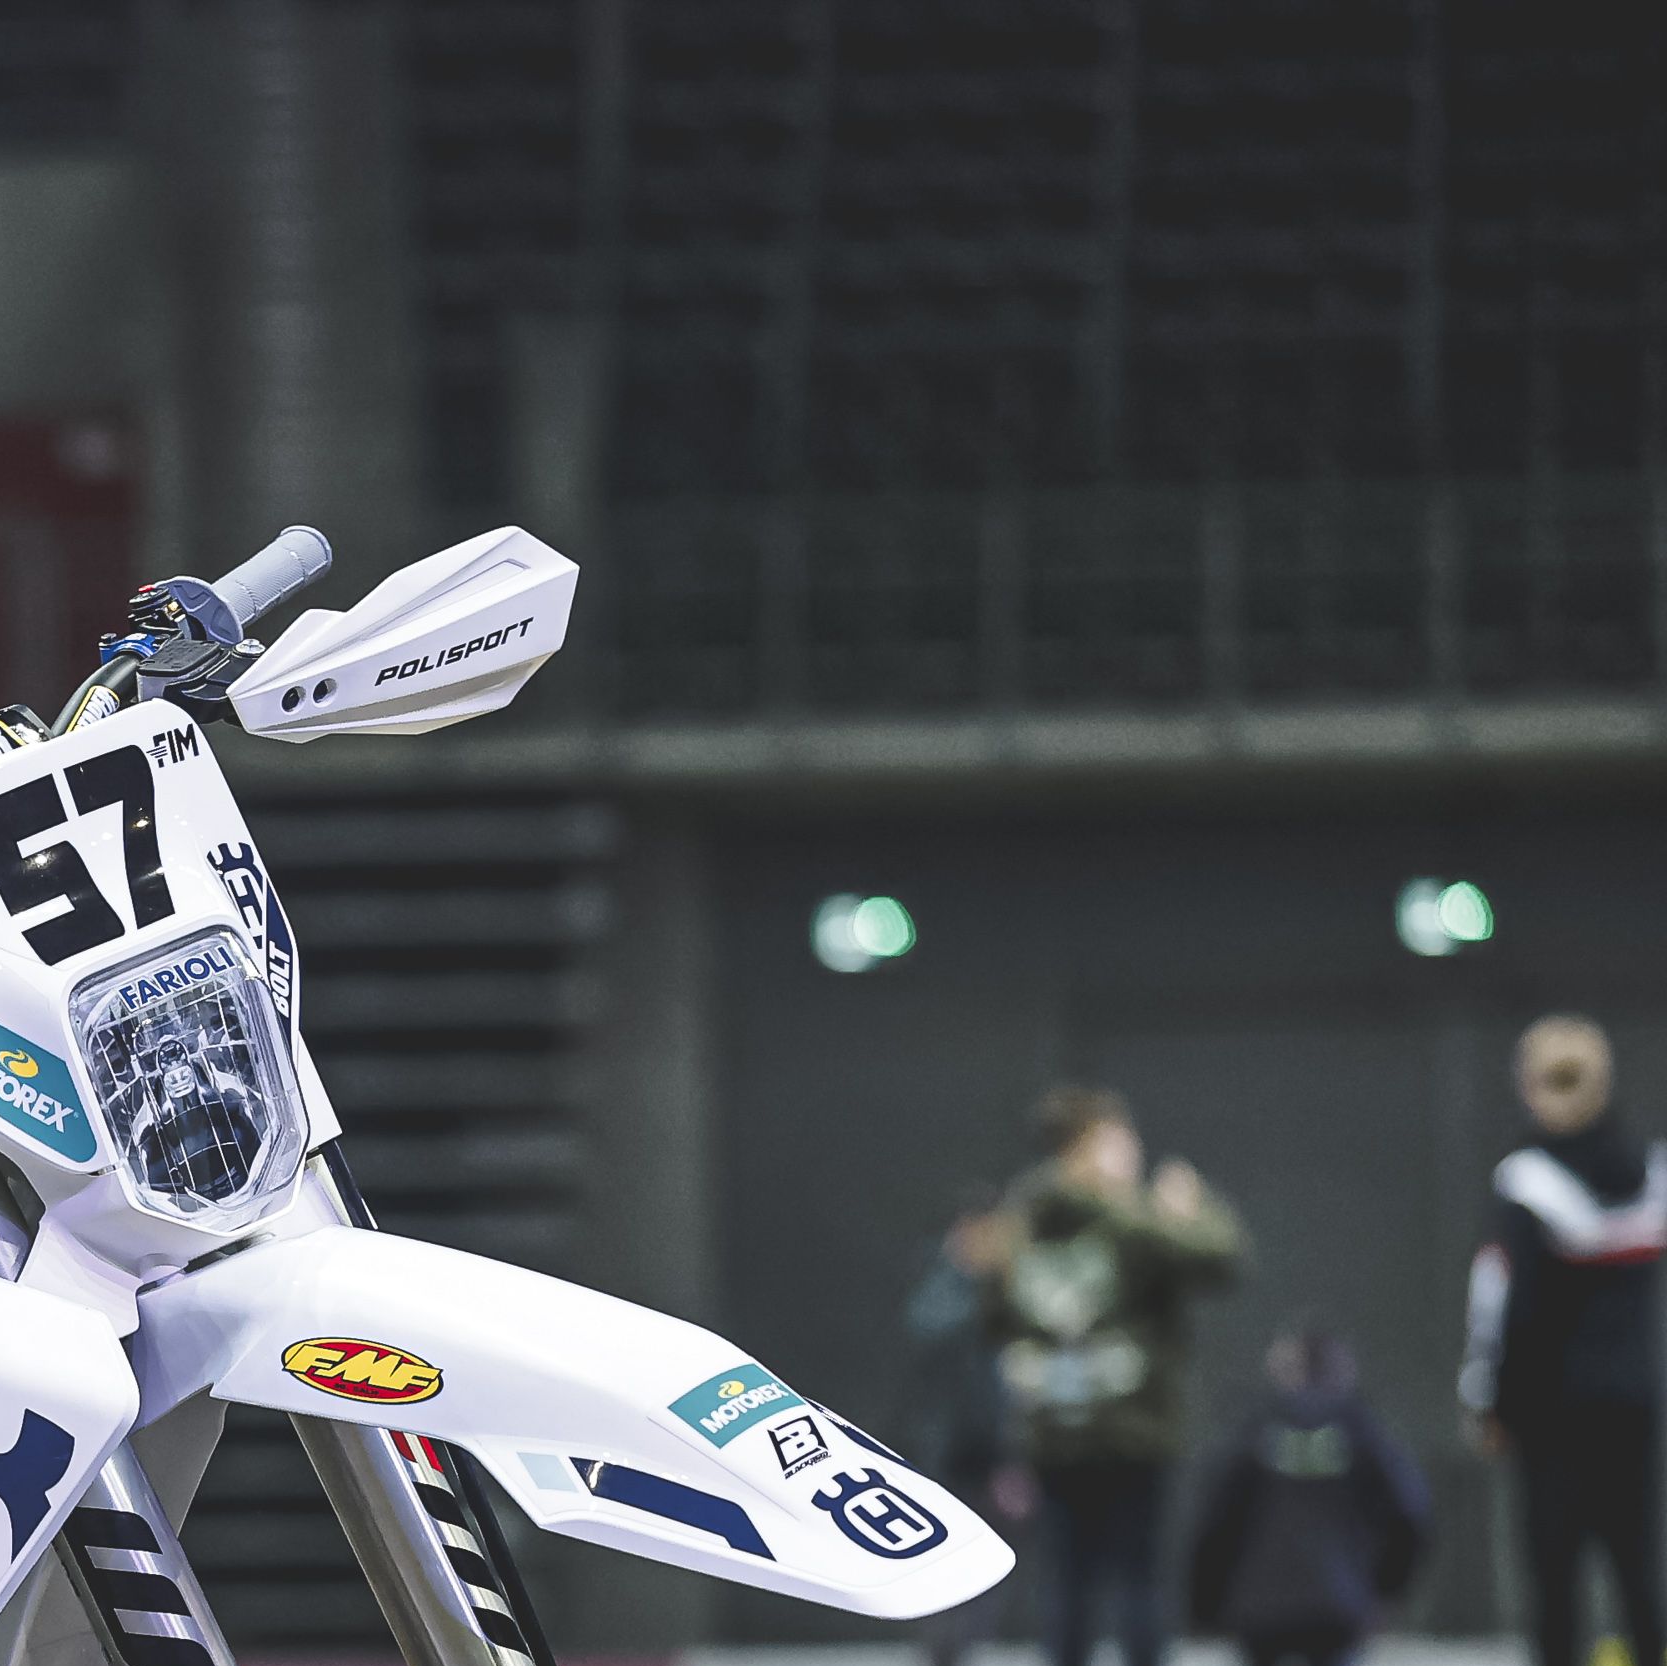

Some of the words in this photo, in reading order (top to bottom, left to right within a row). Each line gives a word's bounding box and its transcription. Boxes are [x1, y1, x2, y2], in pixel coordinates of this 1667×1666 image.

[376, 617, 533, 687] POLISPORT
[146, 723, 200, 768] FIM
[118, 946, 236, 1011] FARIOLI
[269, 940, 291, 1018] BOLT
[283, 1343, 443, 1391] FMF
[699, 1382, 789, 1435] MOTOREX
